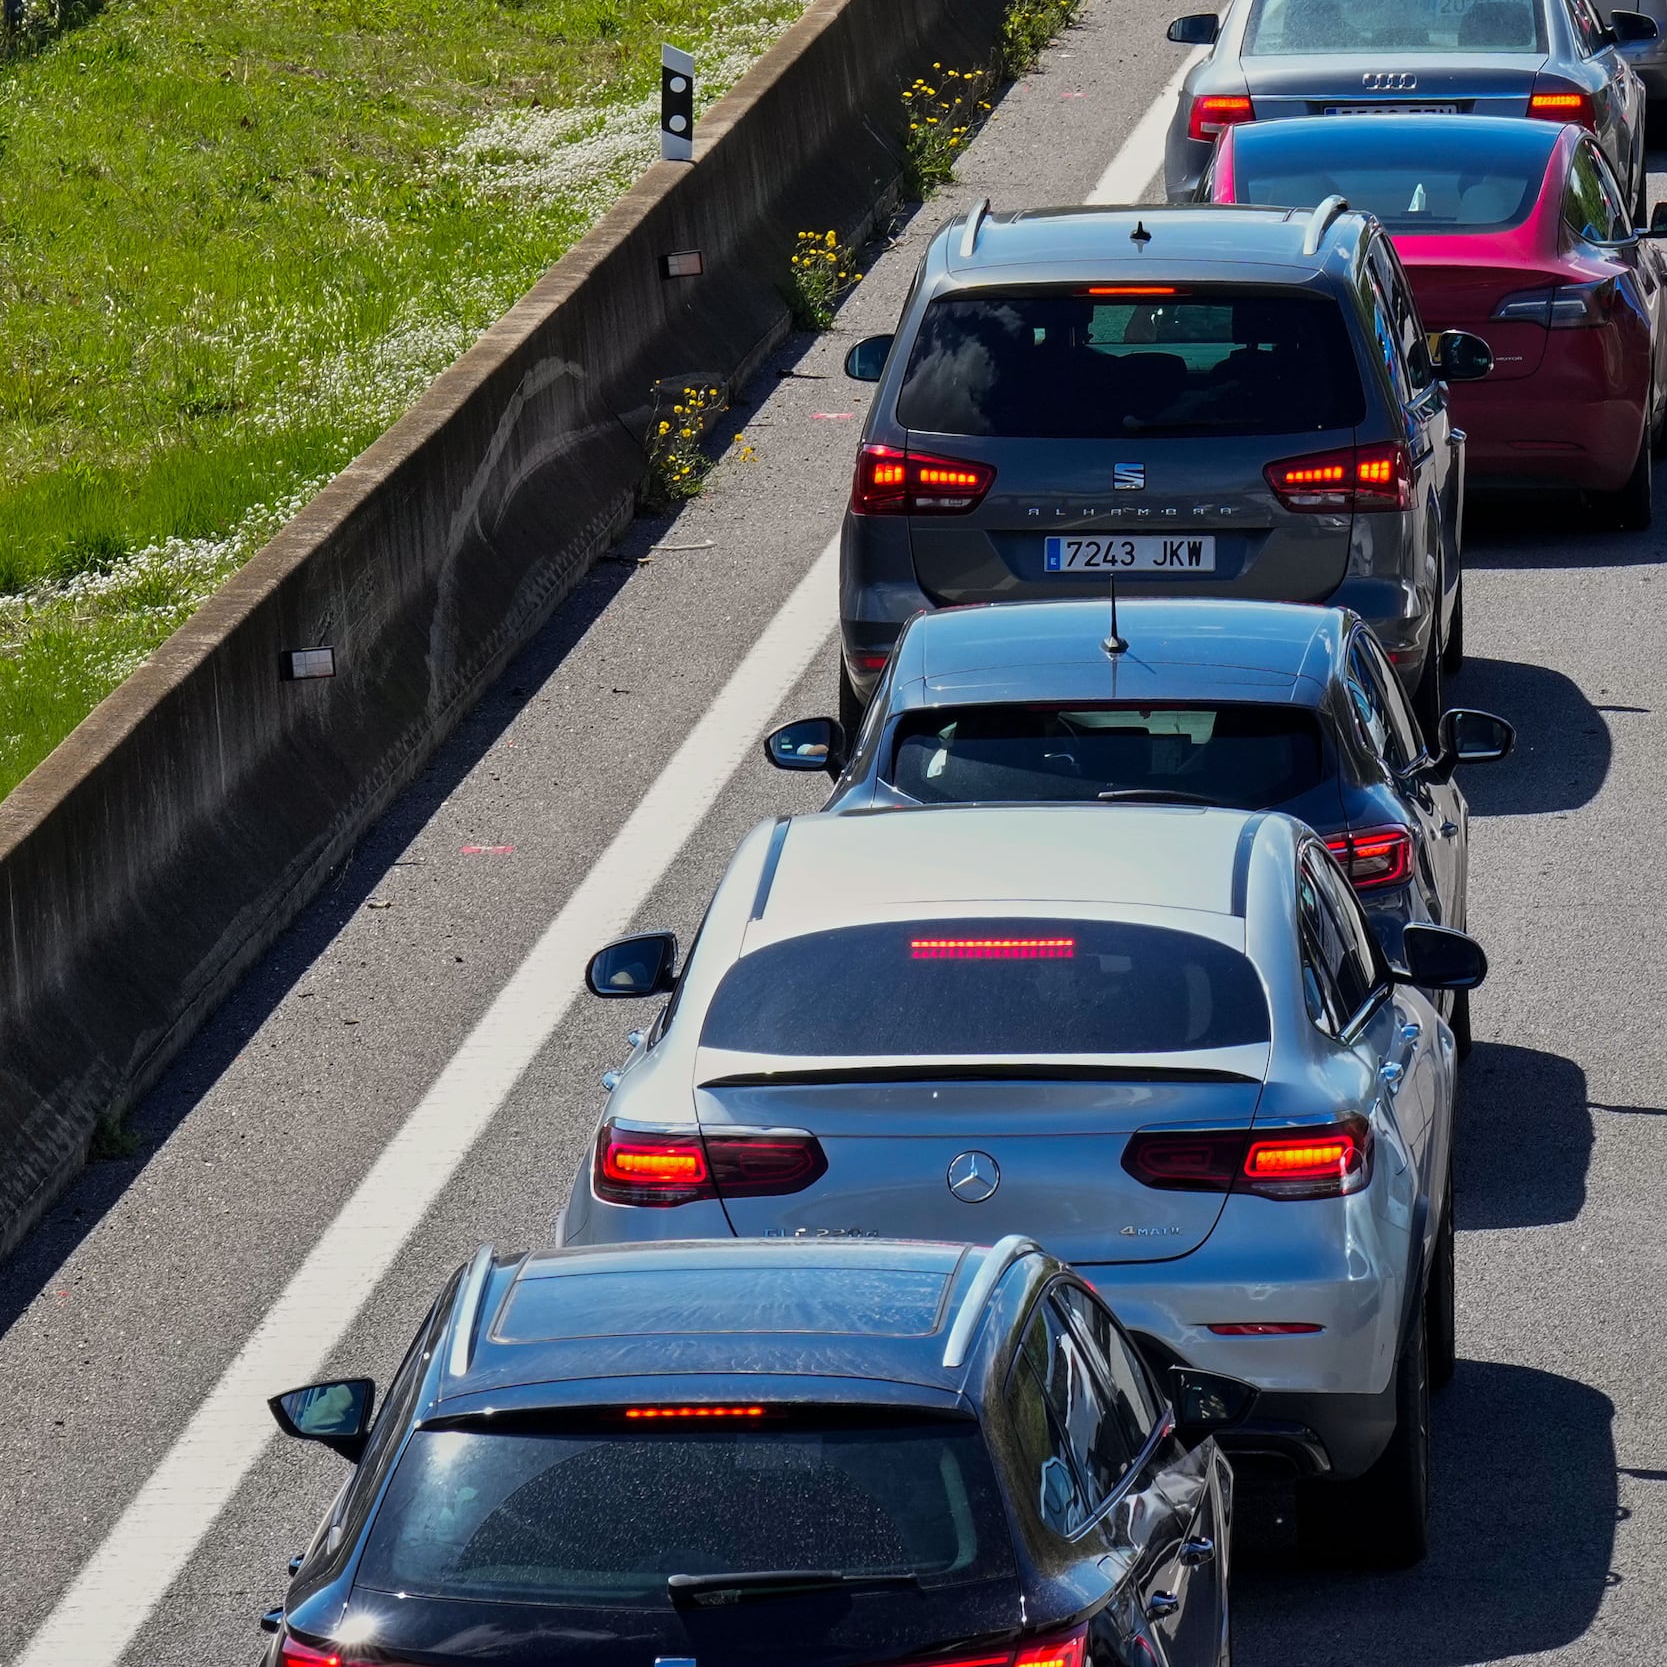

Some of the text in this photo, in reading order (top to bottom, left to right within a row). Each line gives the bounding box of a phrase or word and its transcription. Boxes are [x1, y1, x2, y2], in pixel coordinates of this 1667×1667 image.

[1028, 507, 1233, 516] ALHAMBRA
[1066, 541, 1136, 568] 7243
[1152, 541, 1203, 568] JKW
